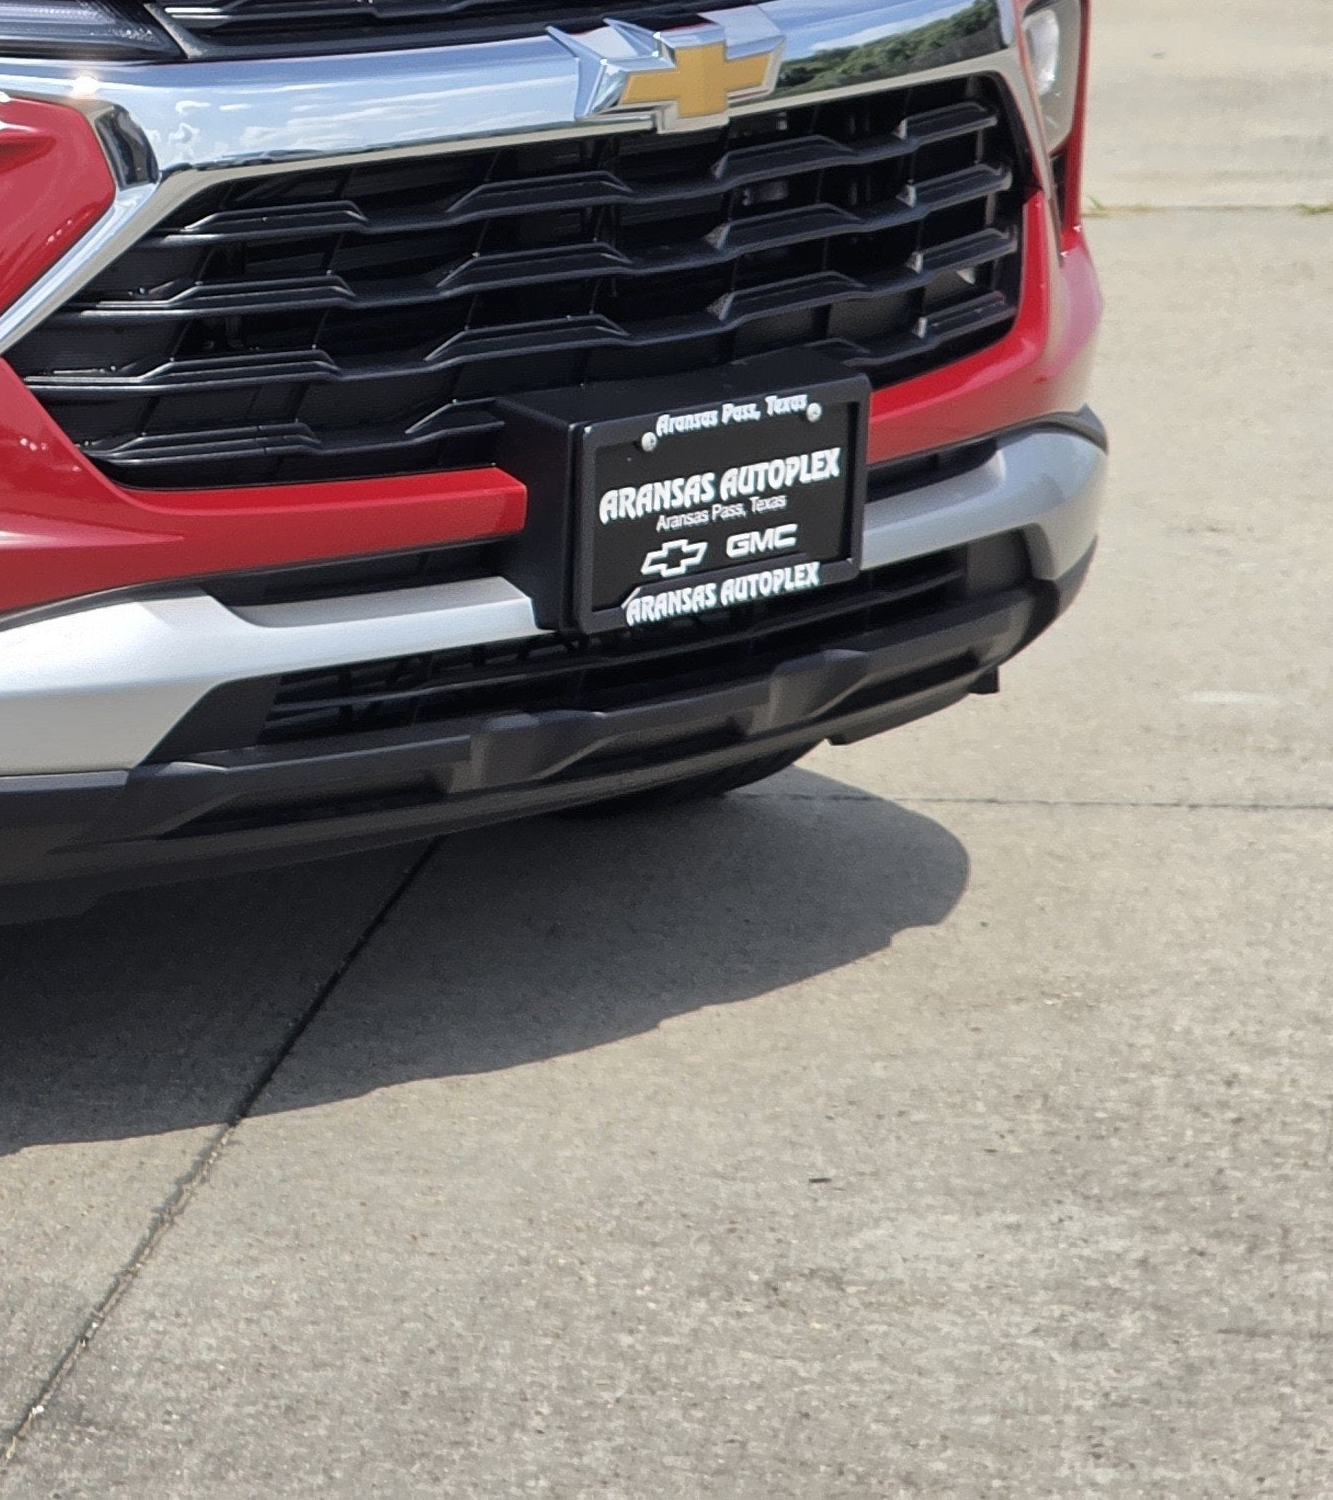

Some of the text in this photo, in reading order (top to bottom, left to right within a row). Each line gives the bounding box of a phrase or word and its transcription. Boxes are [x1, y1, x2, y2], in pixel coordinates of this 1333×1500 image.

[655, 409, 719, 437] Aransas
[765, 394, 808, 416] Texas
[599, 447, 841, 525] ARANSAS AUTOPLEX
[656, 494, 788, 533] Aransas Pass, Texas
[726, 523, 799, 558] GMC
[626, 561, 821, 626] ARANSAS AUTOPLEX
